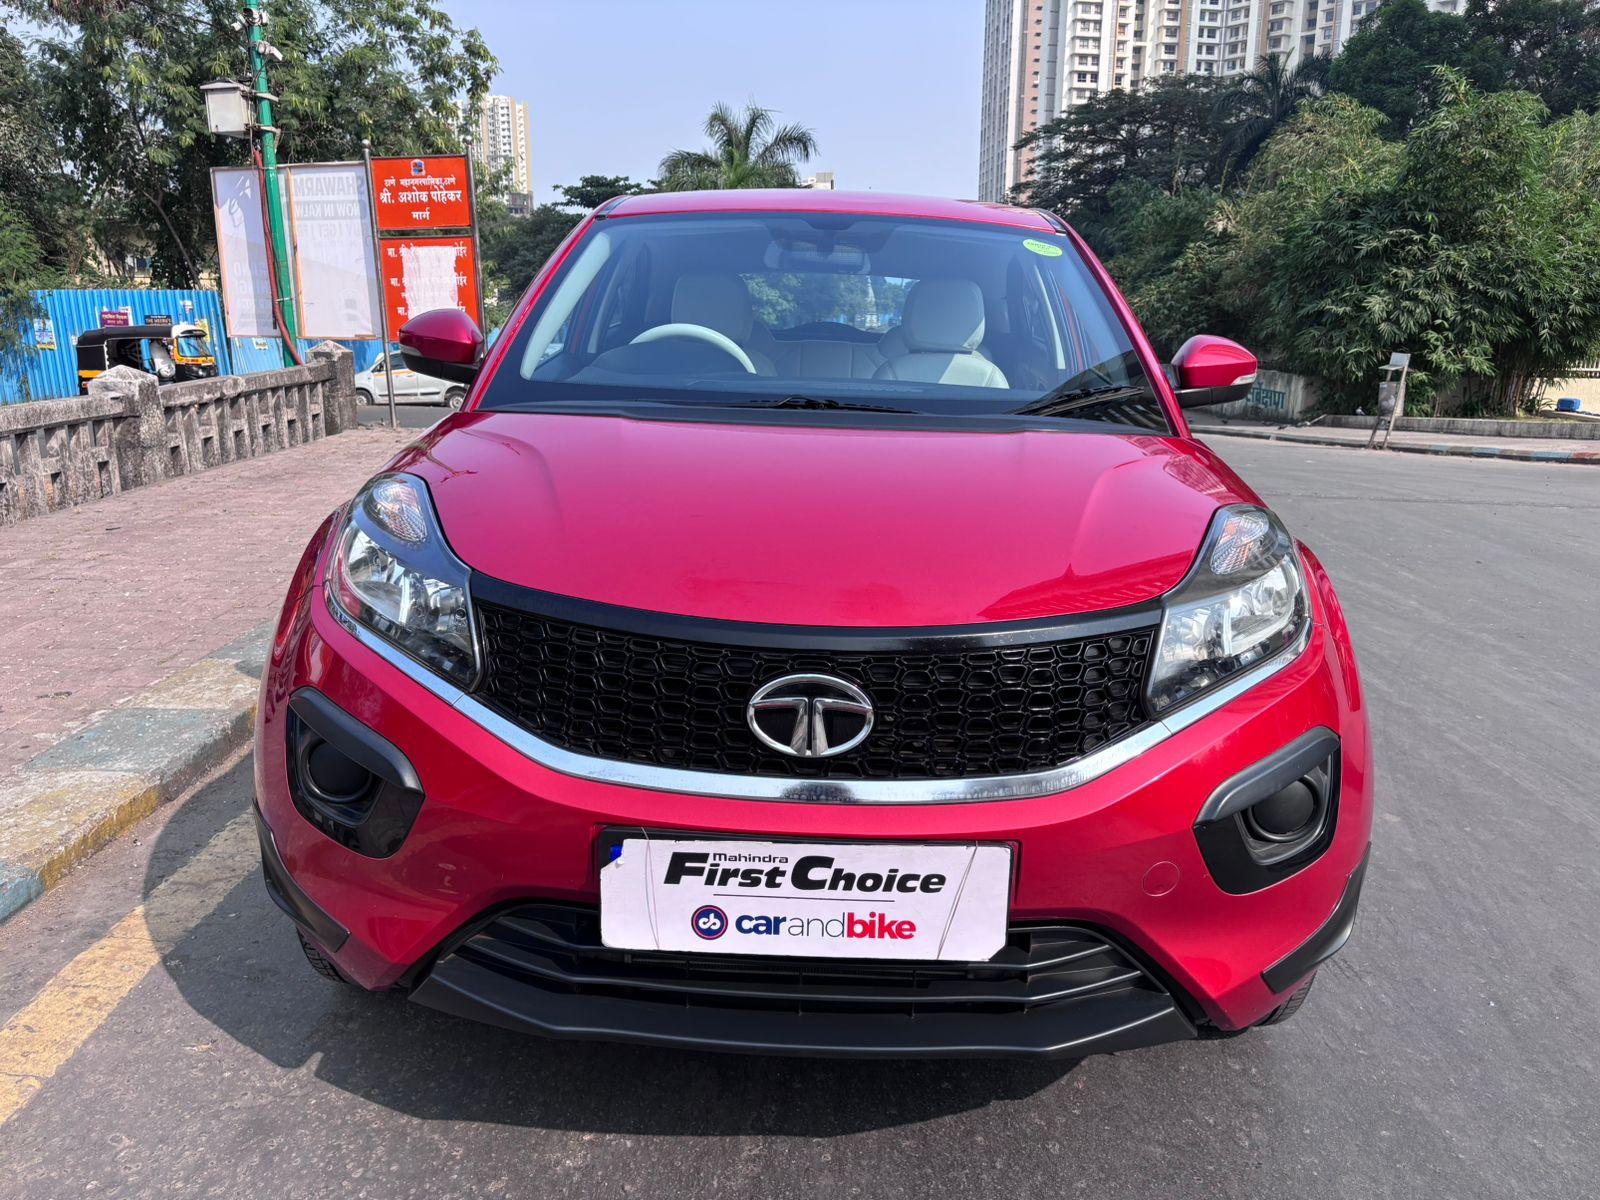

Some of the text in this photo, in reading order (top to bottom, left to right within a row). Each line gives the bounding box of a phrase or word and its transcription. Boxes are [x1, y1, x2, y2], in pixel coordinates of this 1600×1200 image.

[398, 186, 429, 204] अशोक
[430, 185, 462, 205] पोहेकर
[411, 207, 430, 220] मार्ग
[713, 852, 789, 864] Mahindra
[663, 851, 947, 894] First Choice
